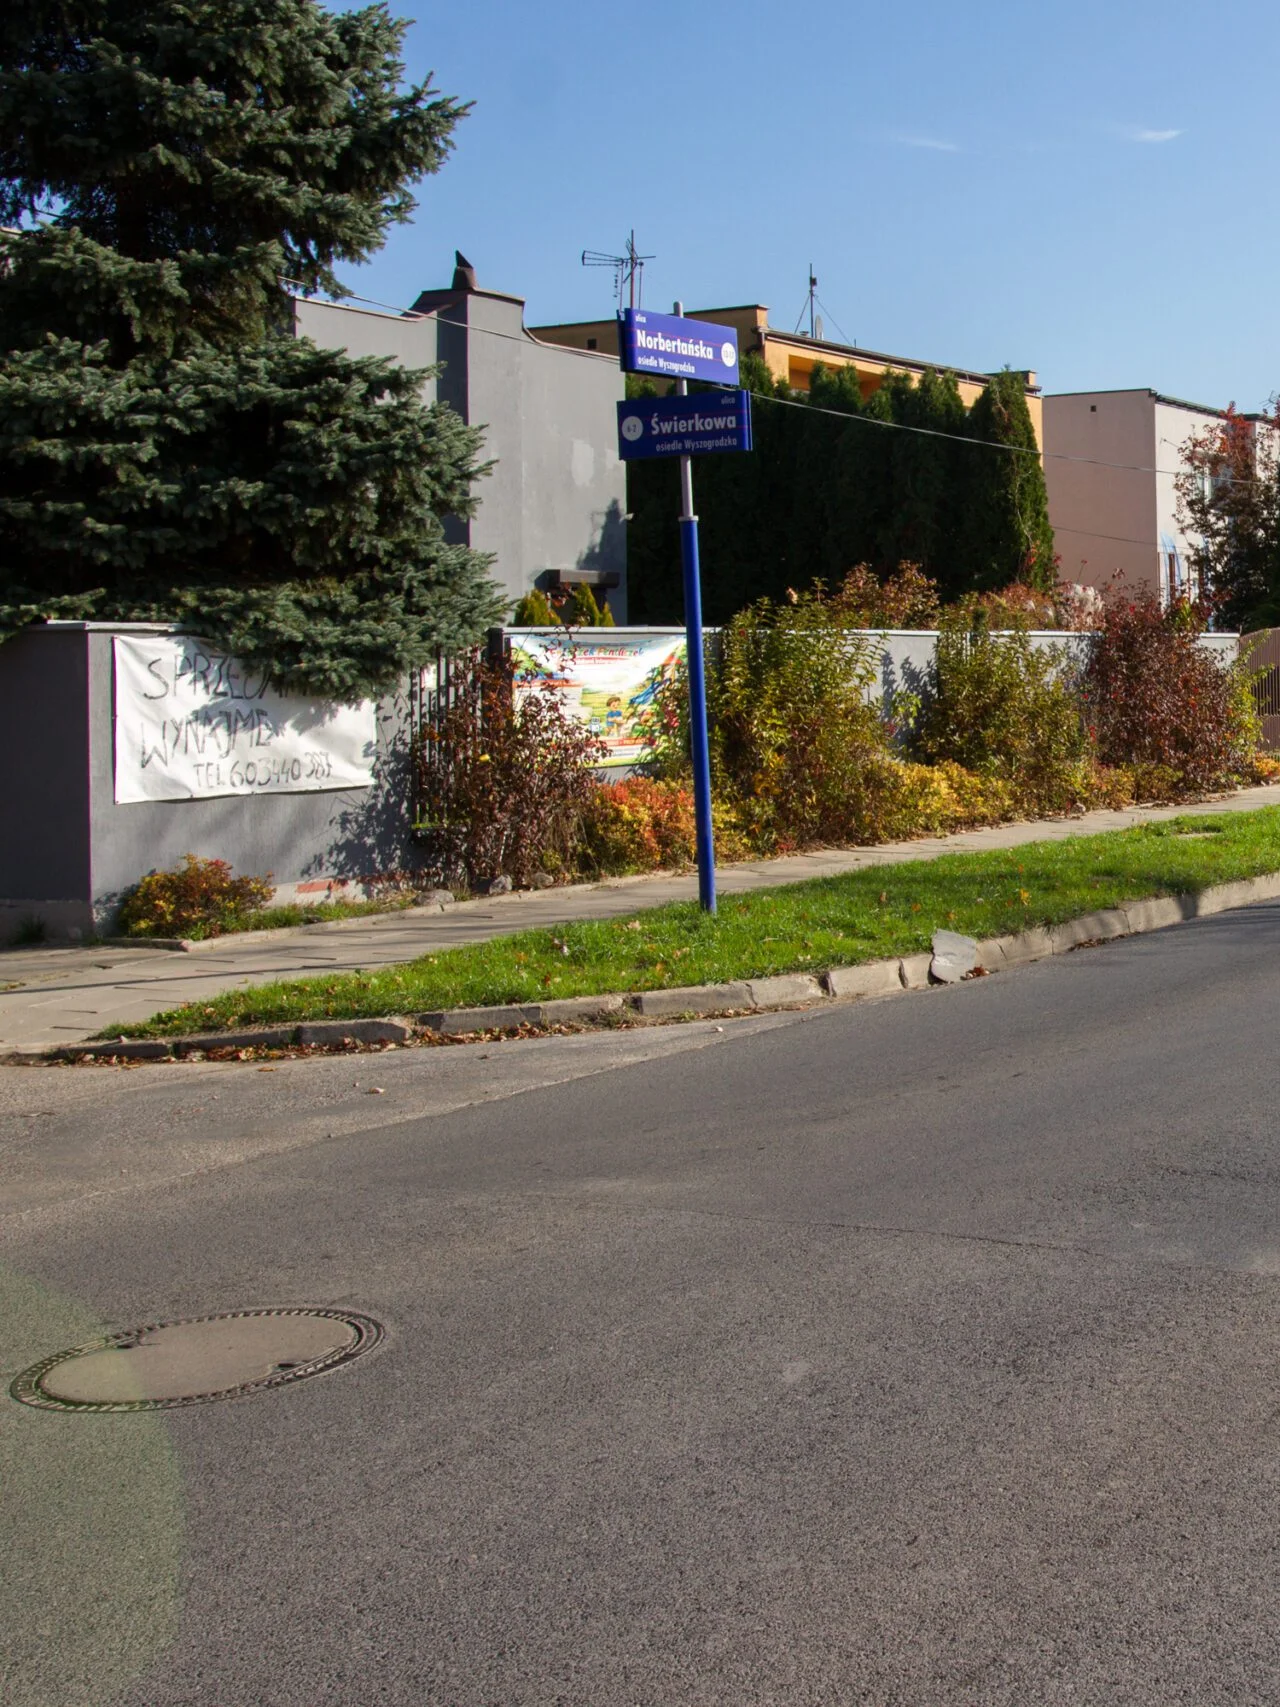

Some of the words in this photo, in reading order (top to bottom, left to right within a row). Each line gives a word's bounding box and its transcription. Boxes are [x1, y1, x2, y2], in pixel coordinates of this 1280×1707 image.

[635, 314, 647, 323] ulica
[636, 329, 714, 360] Norbertańska
[638, 355, 658, 368] osiedle
[658, 357, 696, 374] Wyszogrodzka
[720, 395, 736, 405] ulica
[650, 412, 737, 435] Świerkowa
[655, 439, 682, 452] osiedle
[683, 435, 737, 452] Wyszogrodzka
[141, 653, 307, 700] SPRZEDA
